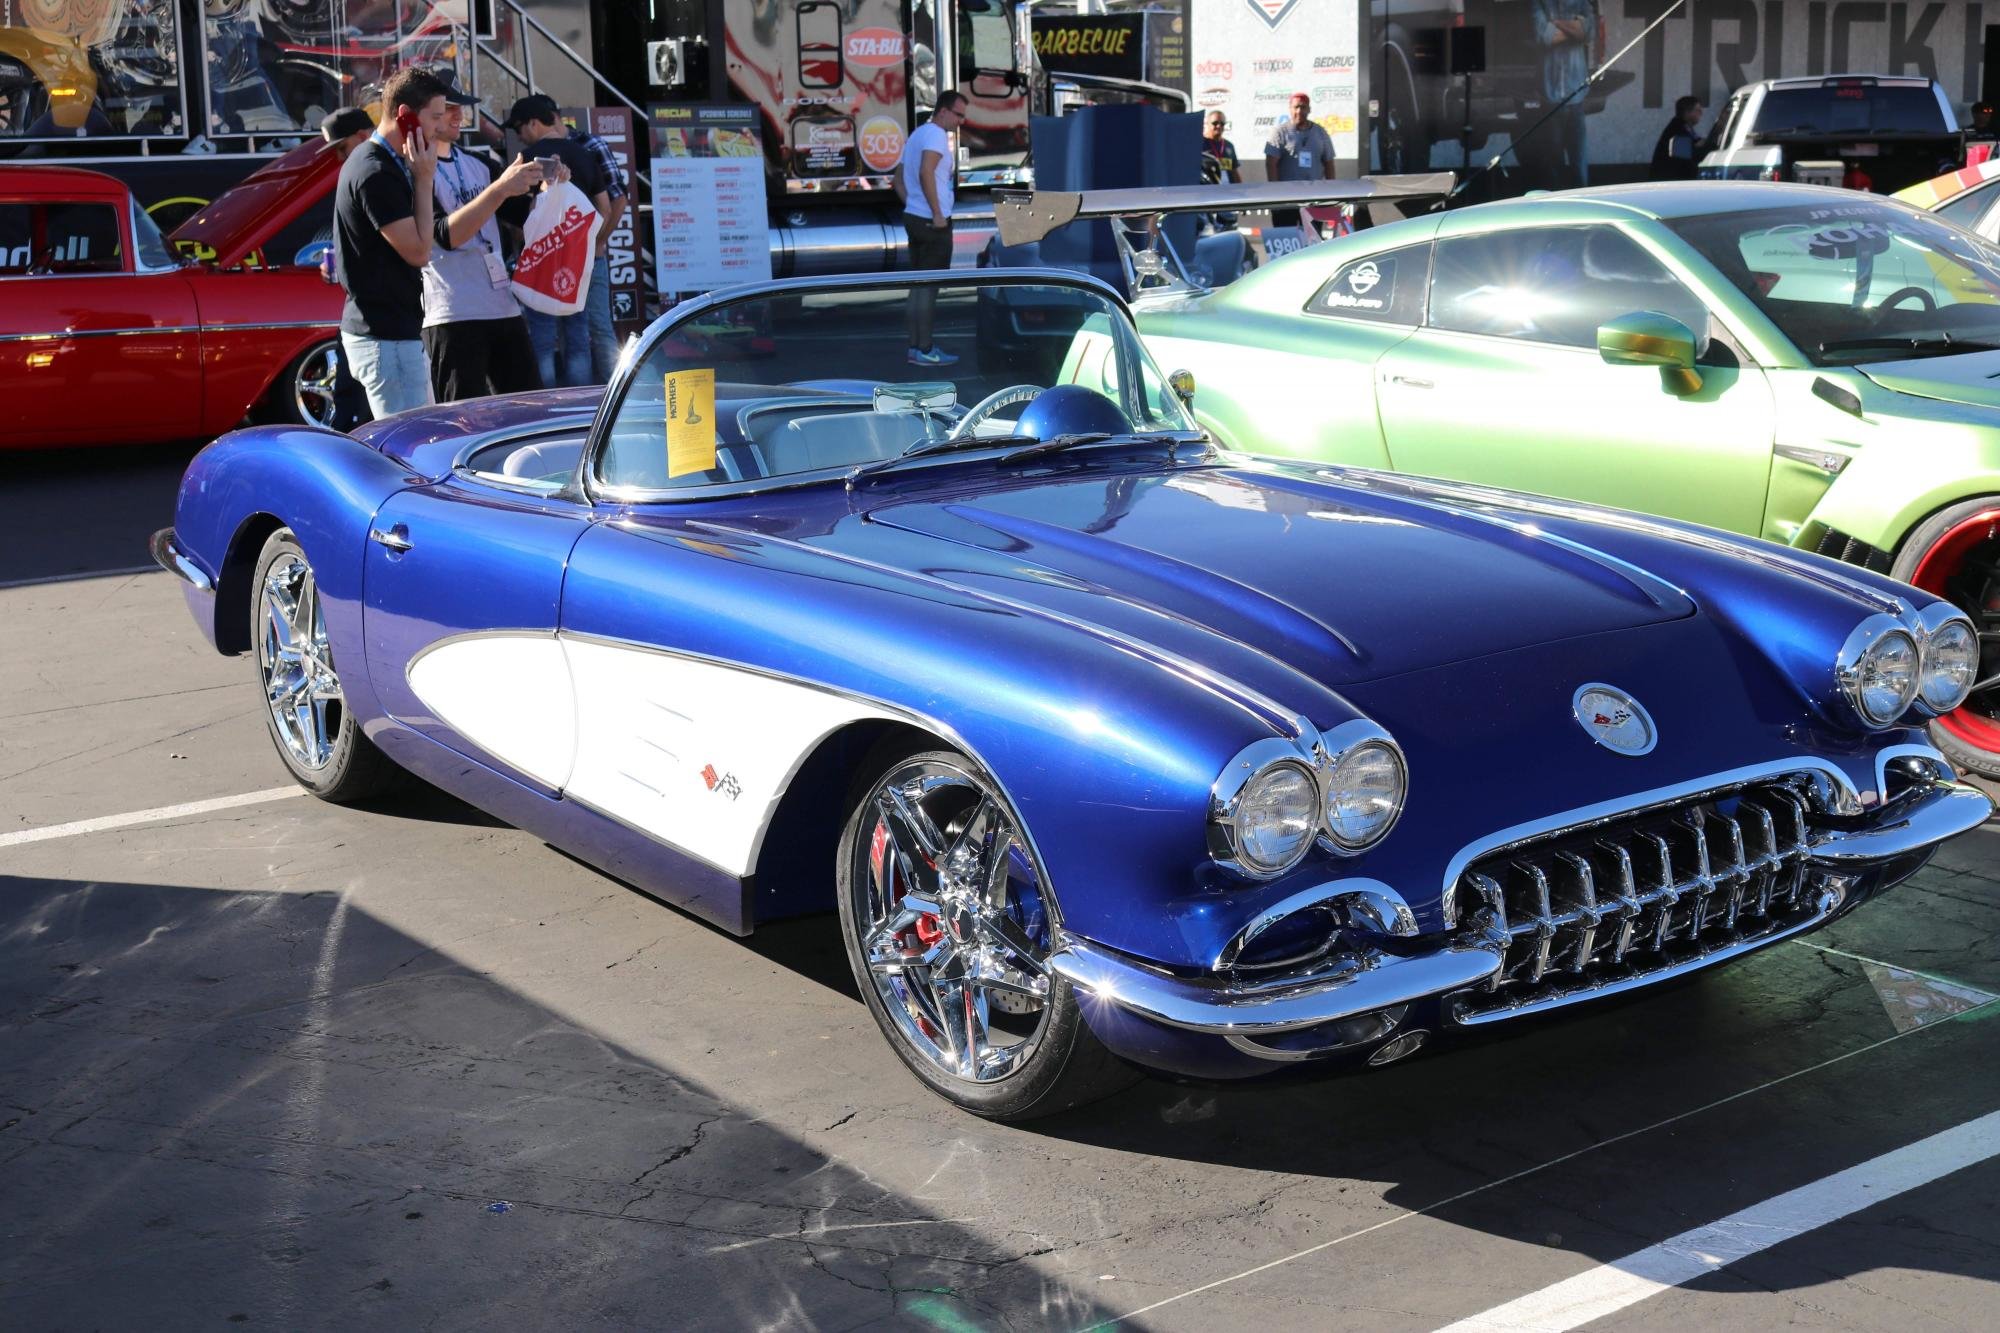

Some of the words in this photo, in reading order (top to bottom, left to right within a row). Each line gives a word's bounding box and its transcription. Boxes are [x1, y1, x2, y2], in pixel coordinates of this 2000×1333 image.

[1031, 28, 1132, 55] BARBECUE
[1313, 55, 1355, 68] BEDRUG
[864, 134, 900, 155] 303
[1264, 236, 1300, 255] 1980
[669, 377, 677, 419] MOTHERS
